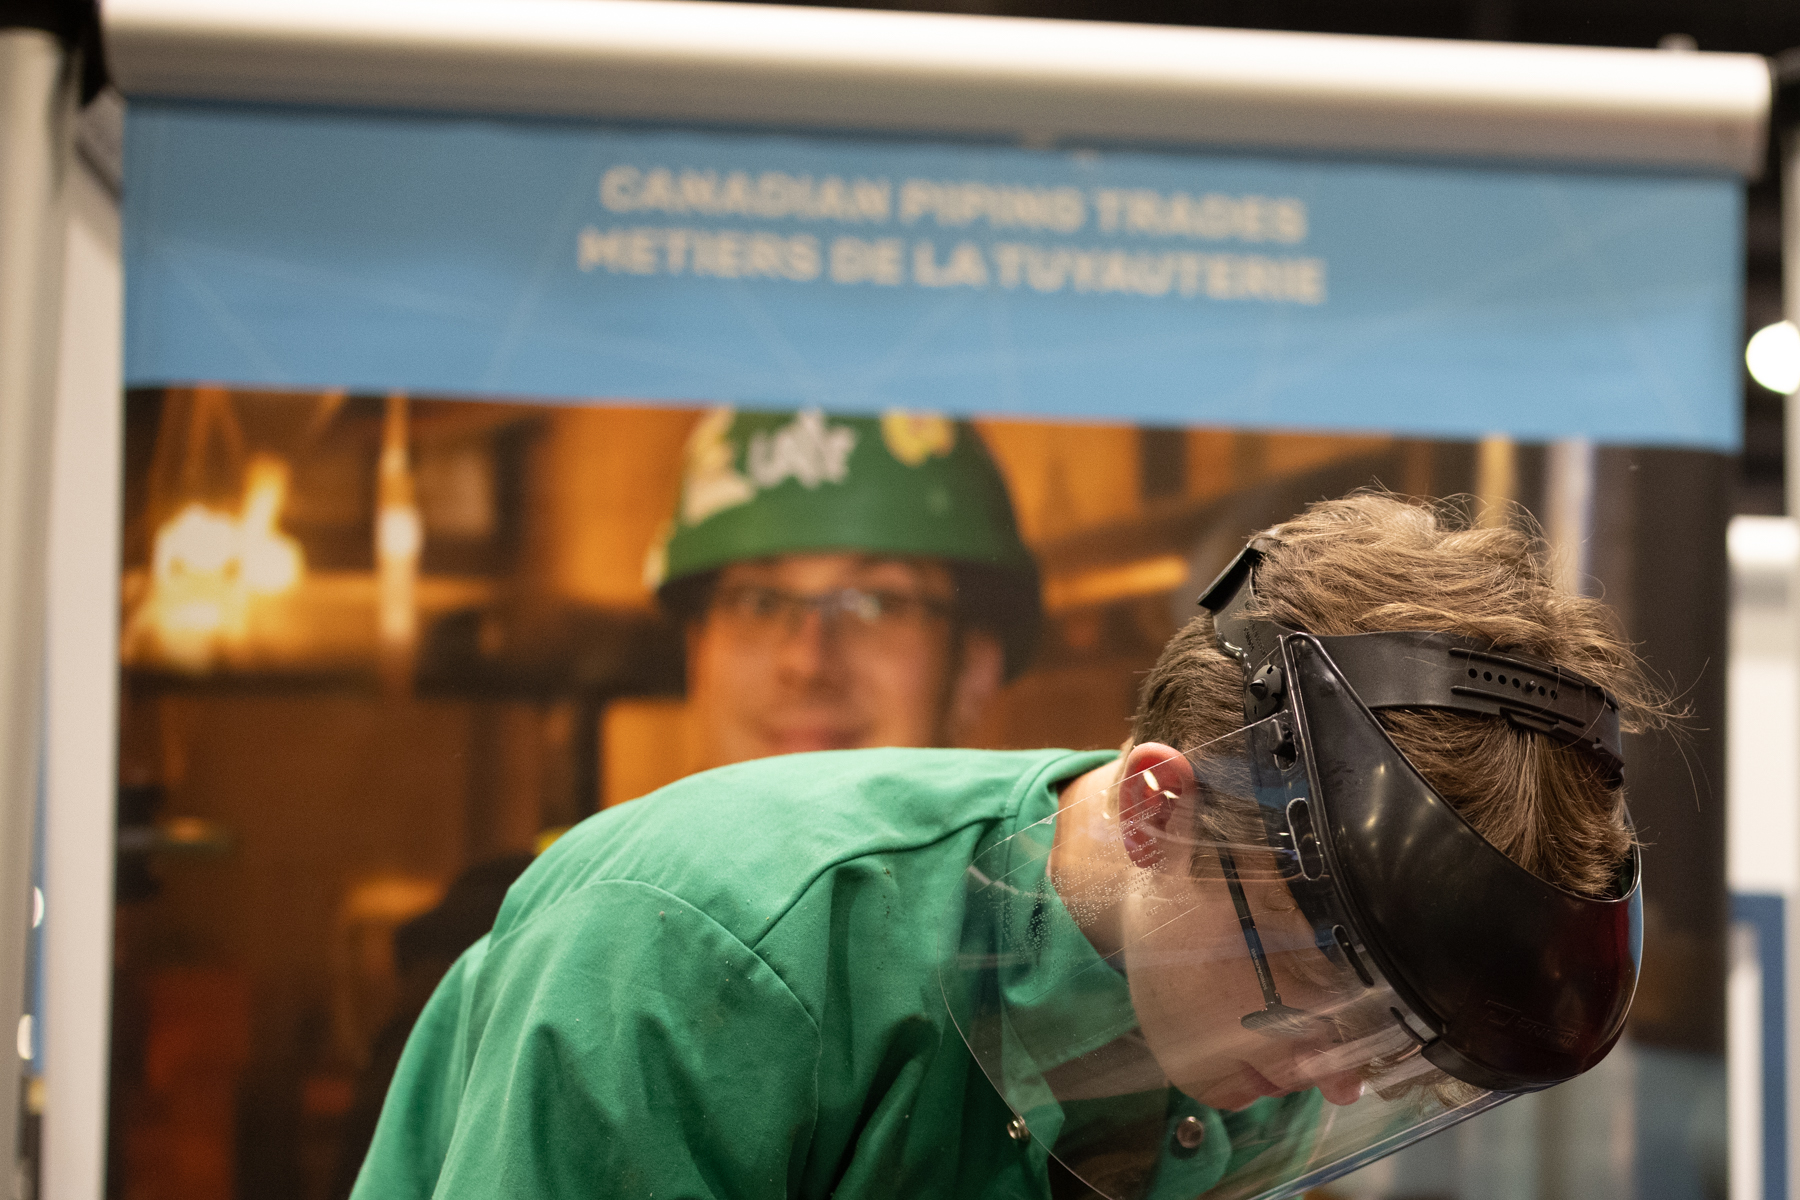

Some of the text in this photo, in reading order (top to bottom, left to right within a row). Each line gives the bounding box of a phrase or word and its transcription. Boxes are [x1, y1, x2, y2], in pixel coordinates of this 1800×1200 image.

[601, 166, 1307, 243] CANADIAN PIPING TRADES
[830, 236, 903, 285] DE
[914, 240, 988, 288] LA
[995, 243, 1326, 304] TUYAUTERIE
